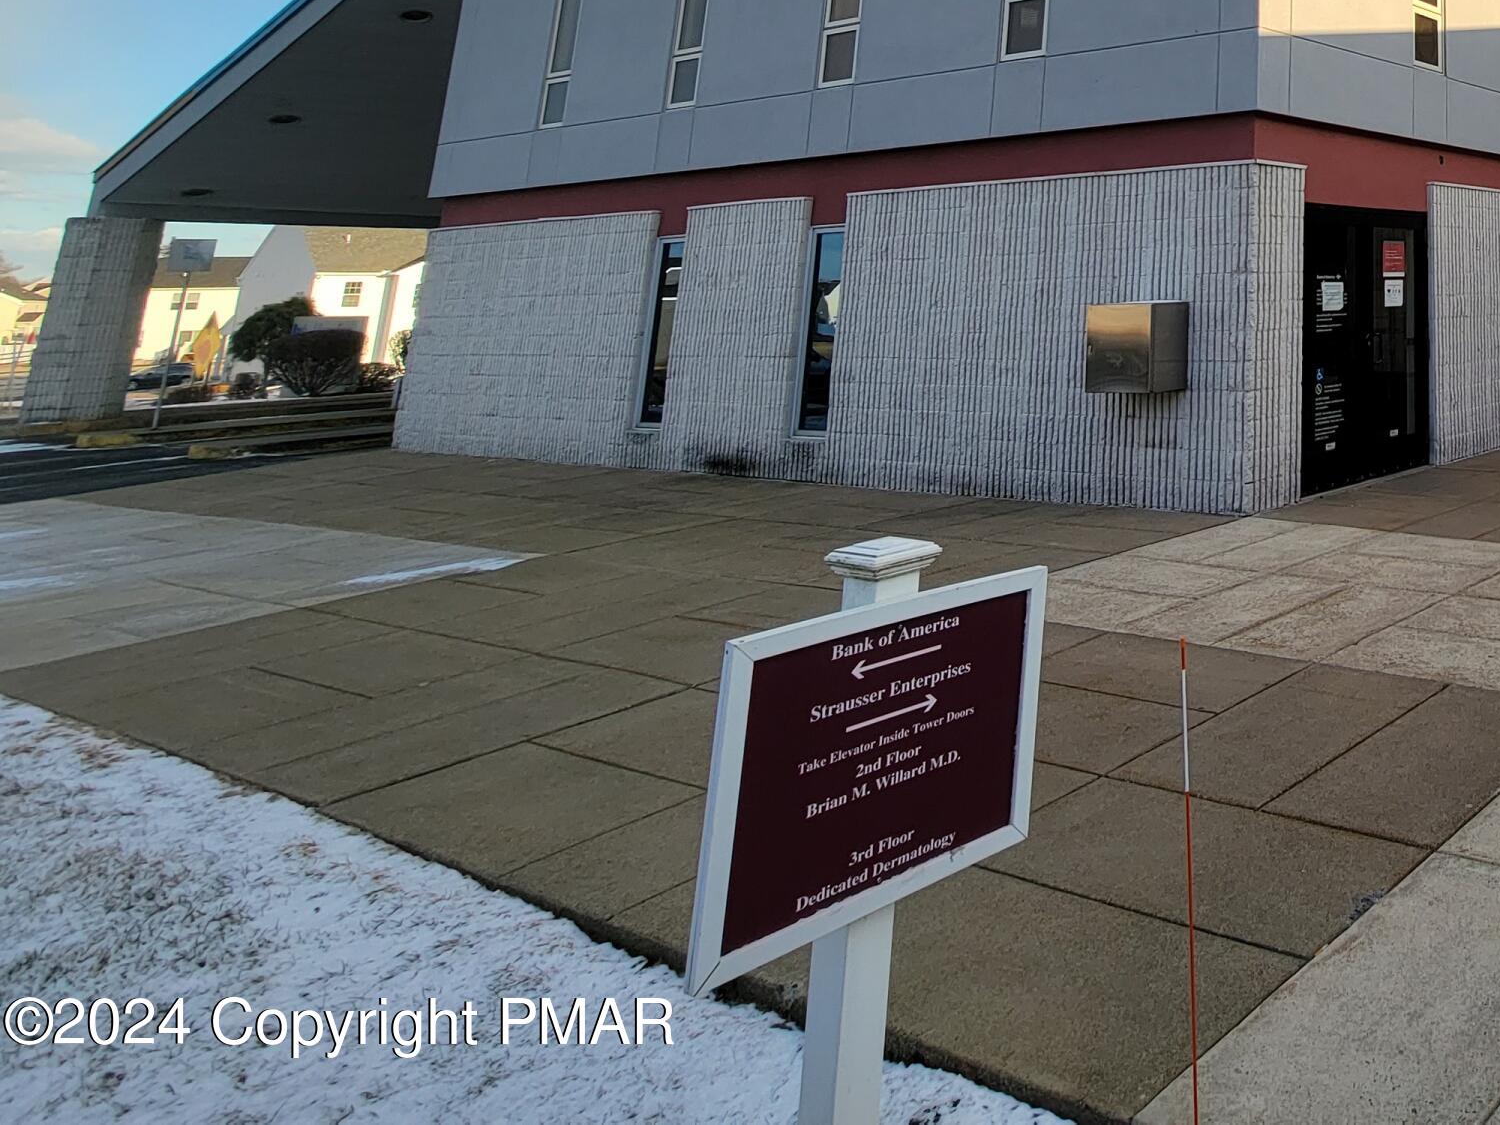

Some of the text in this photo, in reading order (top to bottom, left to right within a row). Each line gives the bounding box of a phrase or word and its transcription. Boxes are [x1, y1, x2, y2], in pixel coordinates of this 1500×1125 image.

[831, 616, 960, 661] Bank of America
[810, 662, 972, 723] Strausser Enterprises
[798, 706, 975, 776] Take Elevator Inside Tower Doors
[855, 745, 922, 778] 2nd Floor
[806, 750, 961, 819] Brian M. Willard M.D.
[795, 831, 956, 913] Dedicated Dermatology
[848, 830, 916, 866] 3rd Floor
